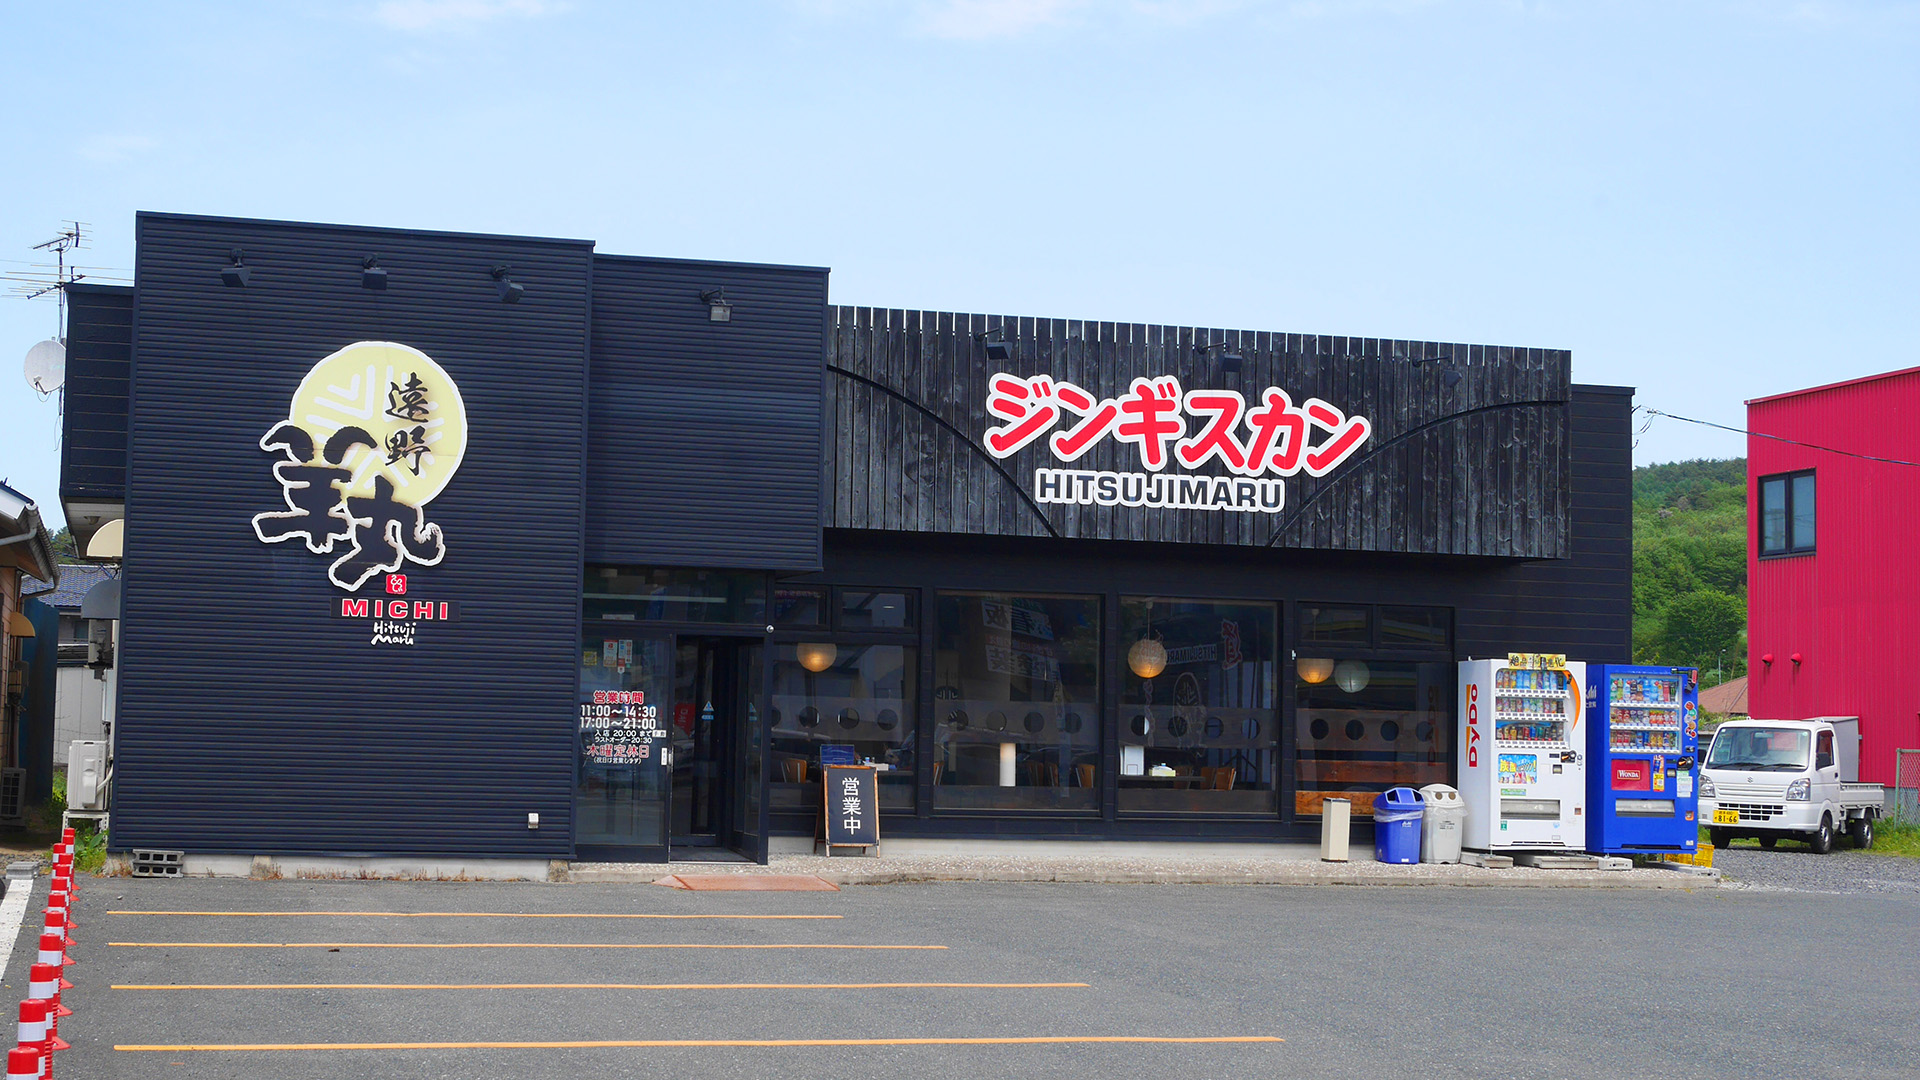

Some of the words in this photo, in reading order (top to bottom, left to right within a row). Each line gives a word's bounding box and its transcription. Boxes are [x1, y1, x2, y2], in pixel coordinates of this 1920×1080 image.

[385, 372, 431, 475] 遠野
[986, 374, 1370, 477] ジンギスカン
[1037, 470, 1283, 512] HITSUJIMARU
[342, 599, 449, 620] MICHI
[373, 620, 416, 637] Hitsuji
[371, 633, 414, 646] Maru
[594, 690, 644, 704] 営業時間
[586, 744, 649, 758] 木曜定休日
[1618, 769, 1639, 778] WONDA
[842, 777, 862, 835] 営業中
